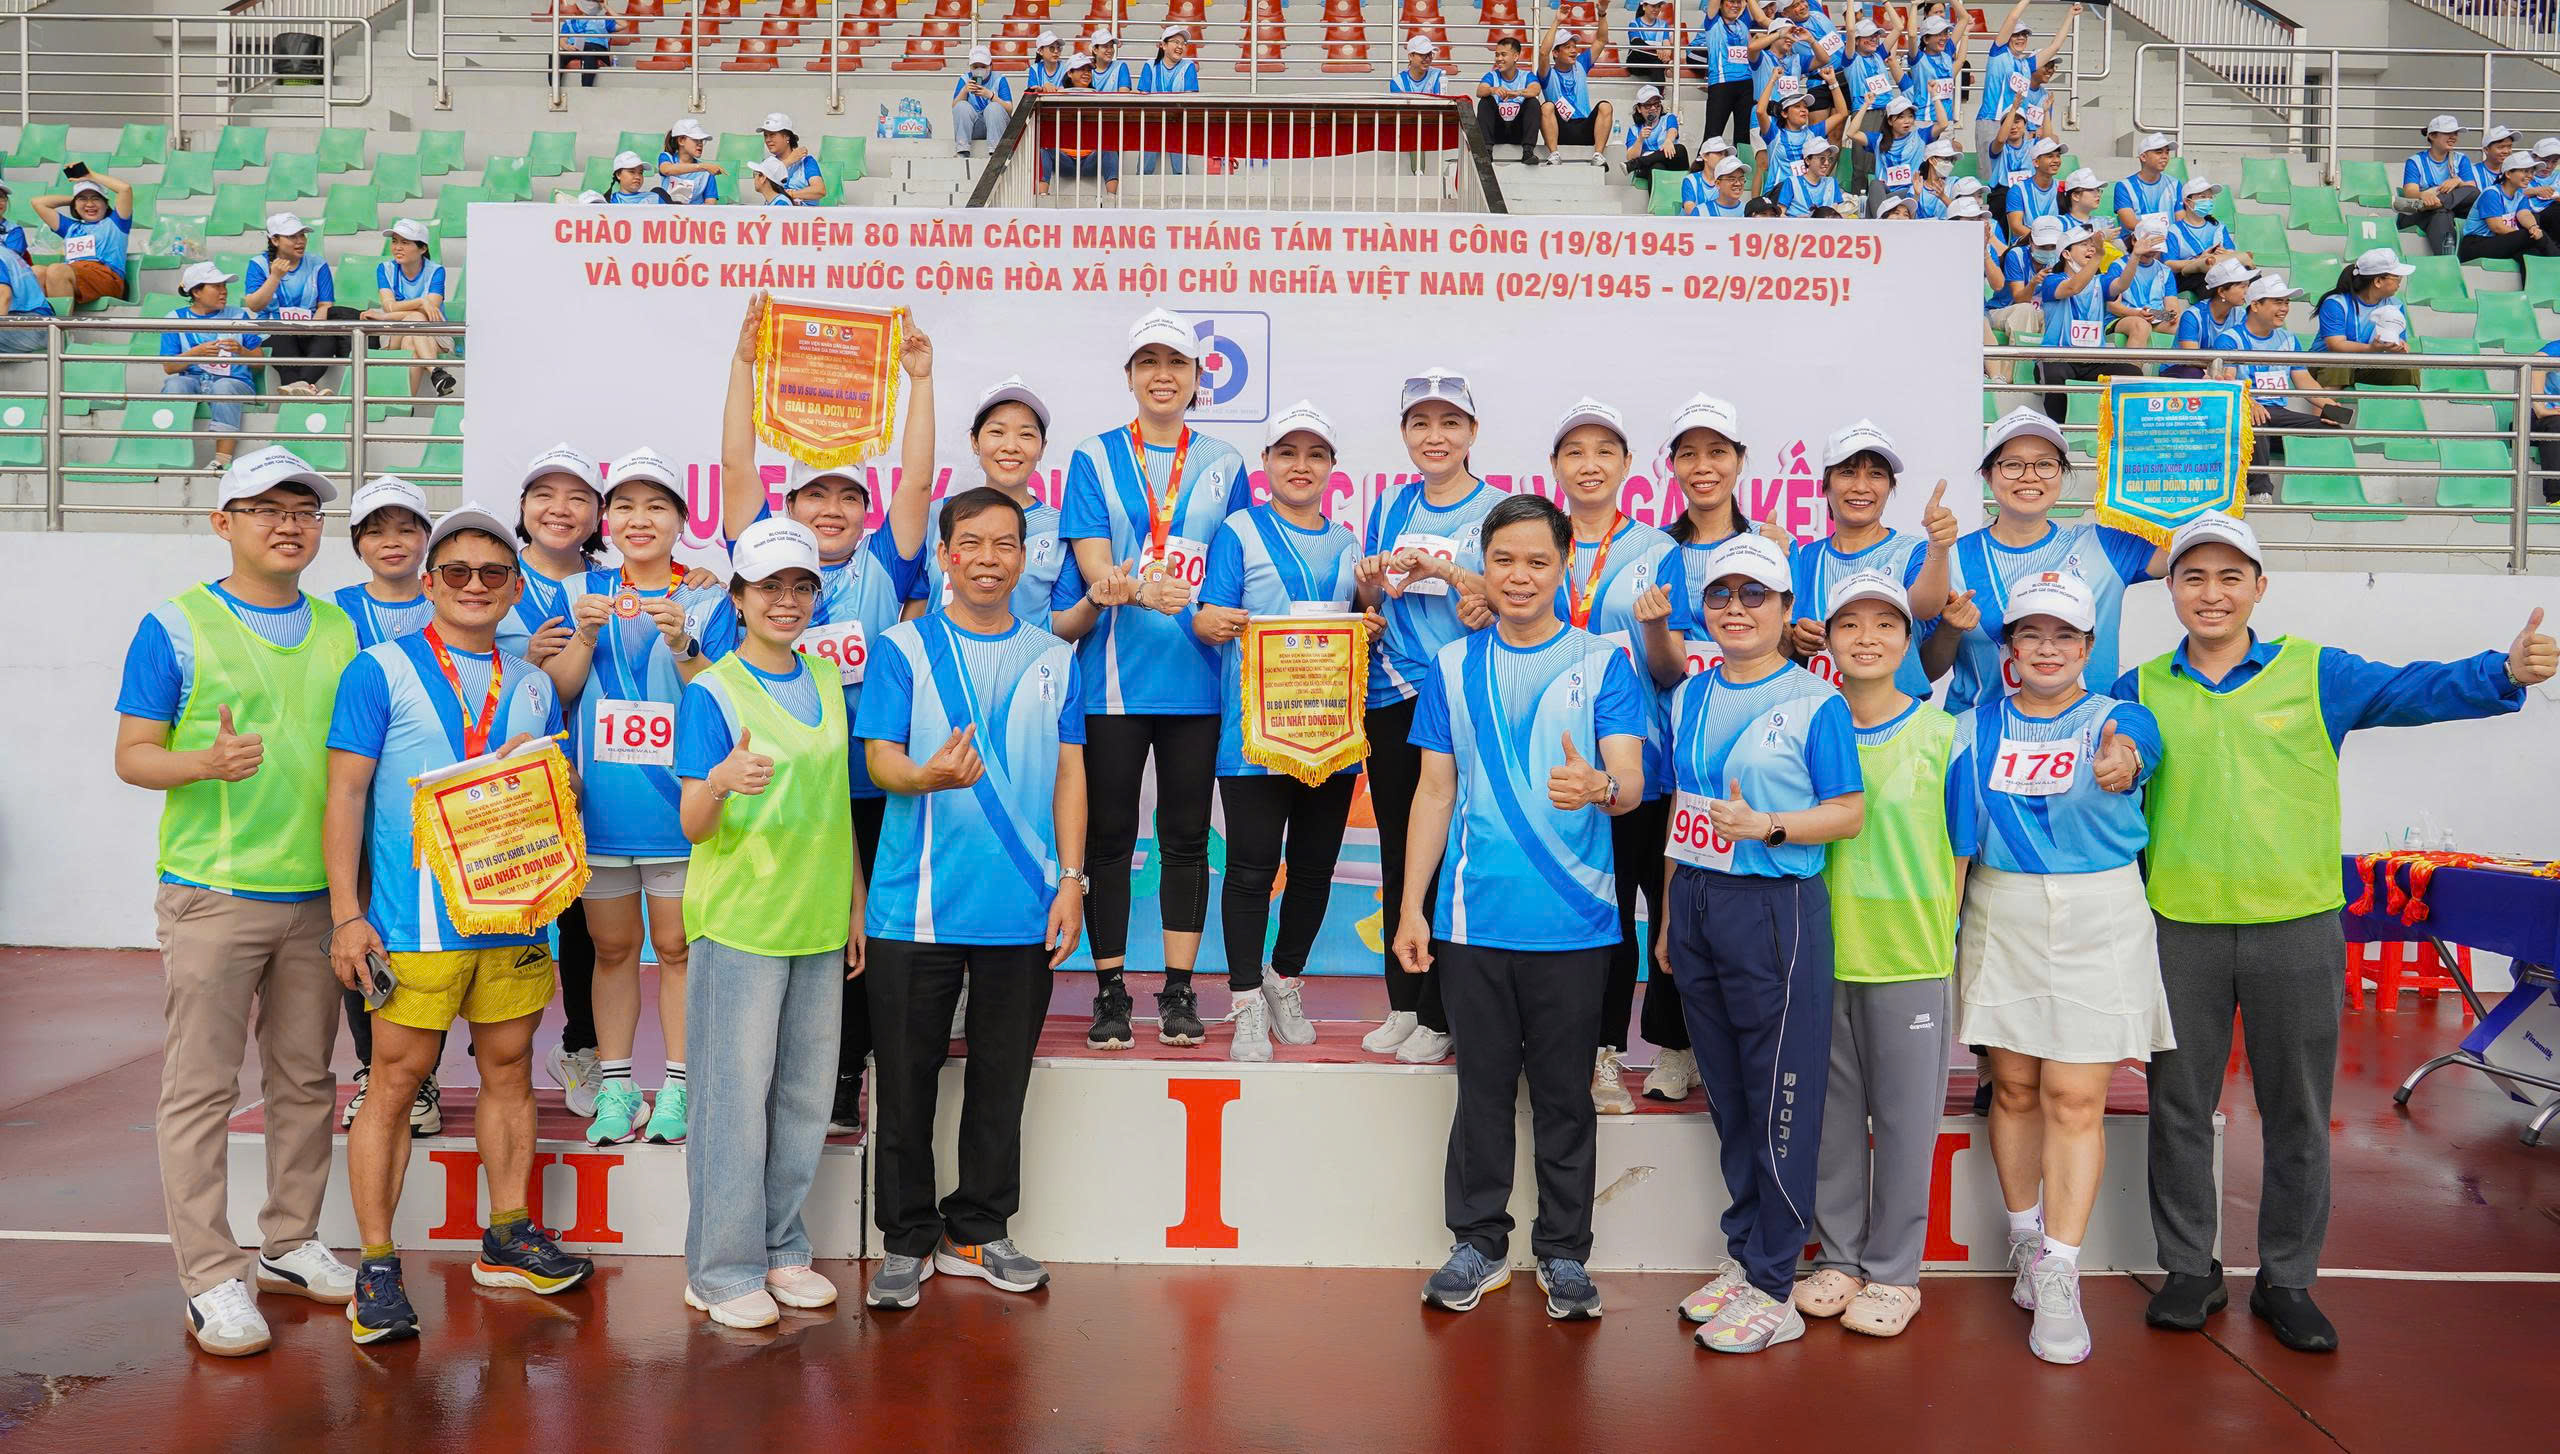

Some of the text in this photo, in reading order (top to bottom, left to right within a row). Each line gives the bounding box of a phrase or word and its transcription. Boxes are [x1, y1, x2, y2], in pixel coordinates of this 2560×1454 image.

[1729, 48, 1749, 60] 052
[1779, 79, 1798, 91] 055
[1869, 77, 1888, 92] 051
[1499, 105, 1519, 117] 087
[1555, 101, 1572, 119] 054
[1889, 168, 1911, 182] 165
[67, 239, 94, 253] 264
[555, 214, 632, 244] CHÀO
[643, 214, 726, 245] MỪNG
[737, 214, 772, 246] KỶ
[781, 216, 853, 252] NIỆM
[864, 223, 899, 248] 80
[910, 218, 973, 249] NĂM
[983, 218, 1062, 249] CÁCH
[1072, 225, 1156, 255] MẠNG
[1166, 220, 1261, 251] THÁNG
[1271, 221, 1332, 252] TÁM
[1343, 222, 1439, 253] THÀNH
[1449, 223, 1528, 254] CÔNG
[1539, 229, 1695, 259] (19/8/1945
[1728, 232, 1883, 265] 19/8/2025)
[585, 256, 622, 286] VÀ
[631, 254, 709, 288] QUỐC
[721, 258, 815, 289] KHÁNH
[827, 259, 905, 289] NƯỚC
[915, 261, 993, 296] CỘNG
[1004, 261, 1062, 291] HÒA
[1072, 262, 1109, 292] XÃ
[1119, 263, 1167, 297] HỘI
[1179, 262, 1237, 294] CHỦ
[1249, 264, 1338, 295] NGHĨA
[1347, 265, 1410, 300] VIỆT
[1419, 271, 1484, 296] NAM
[1496, 273, 1651, 302] (02/9/1945
[1683, 275, 1851, 307] 02/9/2025)!
[2071, 326, 2100, 340] 071
[2257, 376, 2286, 390] 254
[599, 714, 672, 748] 189
[2001, 752, 2075, 780] 178
[543, 851, 565, 868] NAM
[2525, 1030, 2553, 1061] Vinamilk
[1777, 1072, 1796, 1158] SPORT
